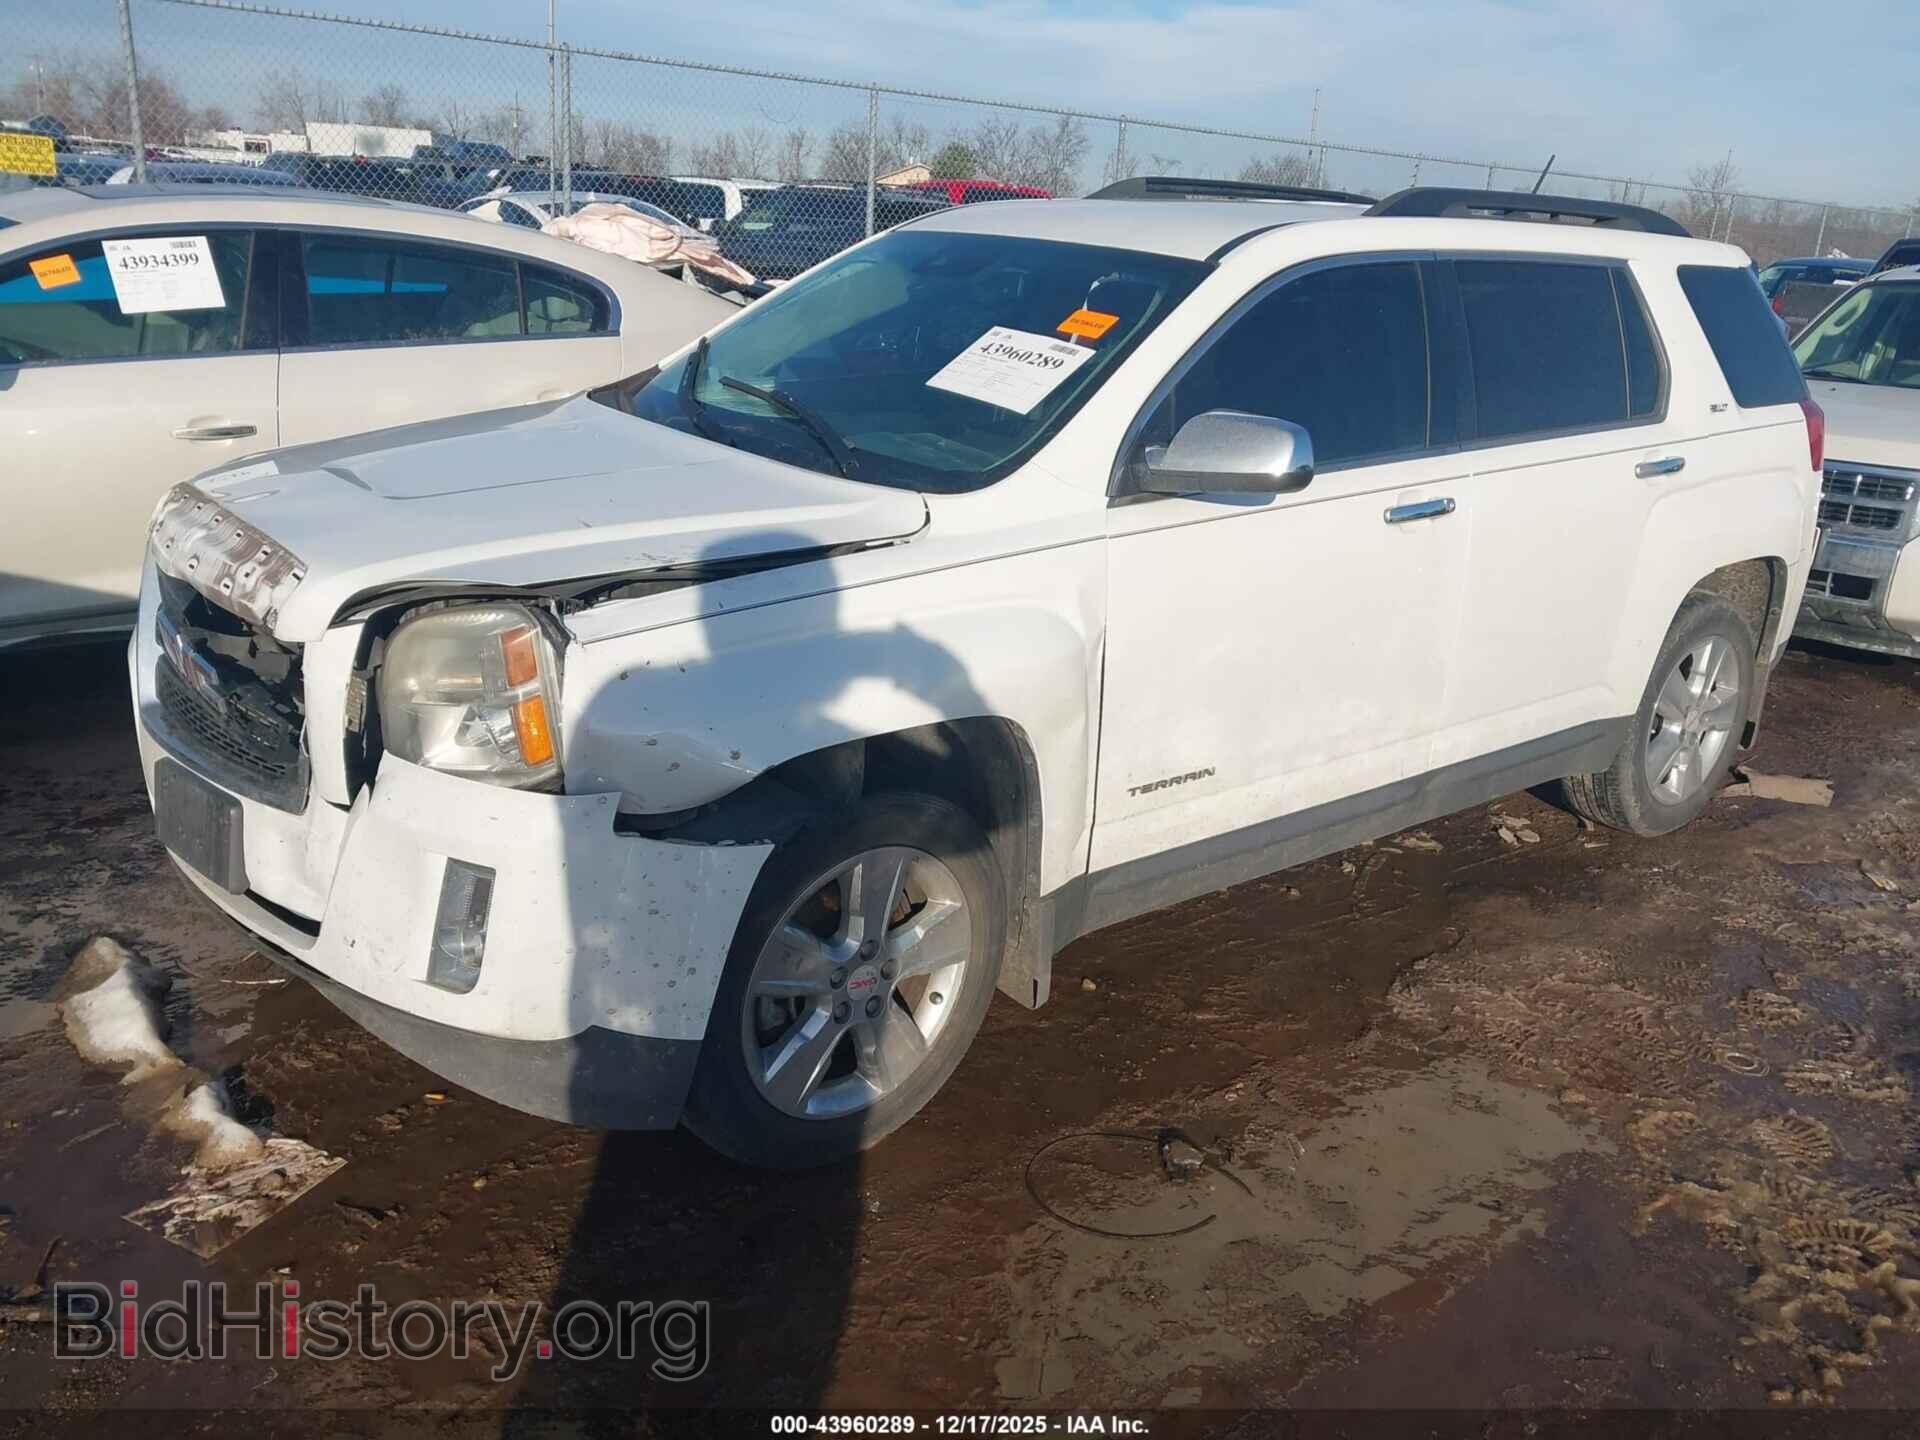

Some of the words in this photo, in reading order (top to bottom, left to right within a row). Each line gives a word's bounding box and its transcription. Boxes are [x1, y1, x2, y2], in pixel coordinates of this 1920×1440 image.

[119, 252, 200, 270] 43934399
[981, 342, 1064, 369] 43960289
[1127, 766, 1216, 797] TERRAIN
